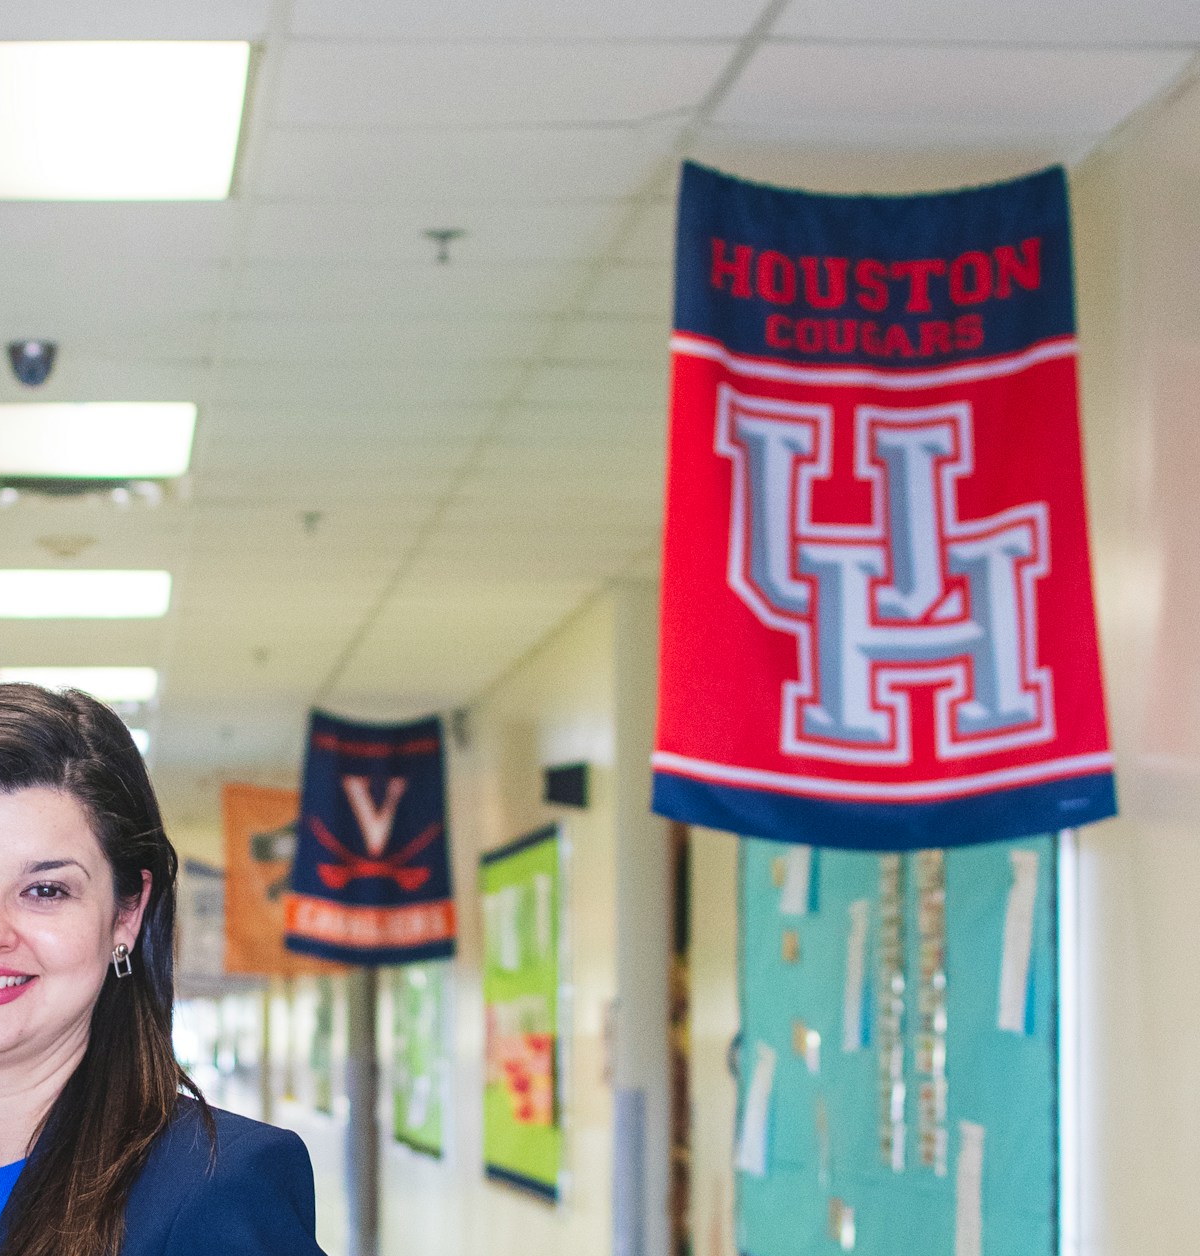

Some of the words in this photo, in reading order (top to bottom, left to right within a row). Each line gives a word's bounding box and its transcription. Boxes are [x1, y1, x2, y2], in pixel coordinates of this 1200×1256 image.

[710, 236, 1042, 313] HOUSTON
[764, 314, 986, 358] COUGARS
[714, 380, 1057, 766] UH
[341, 774, 408, 858] V
